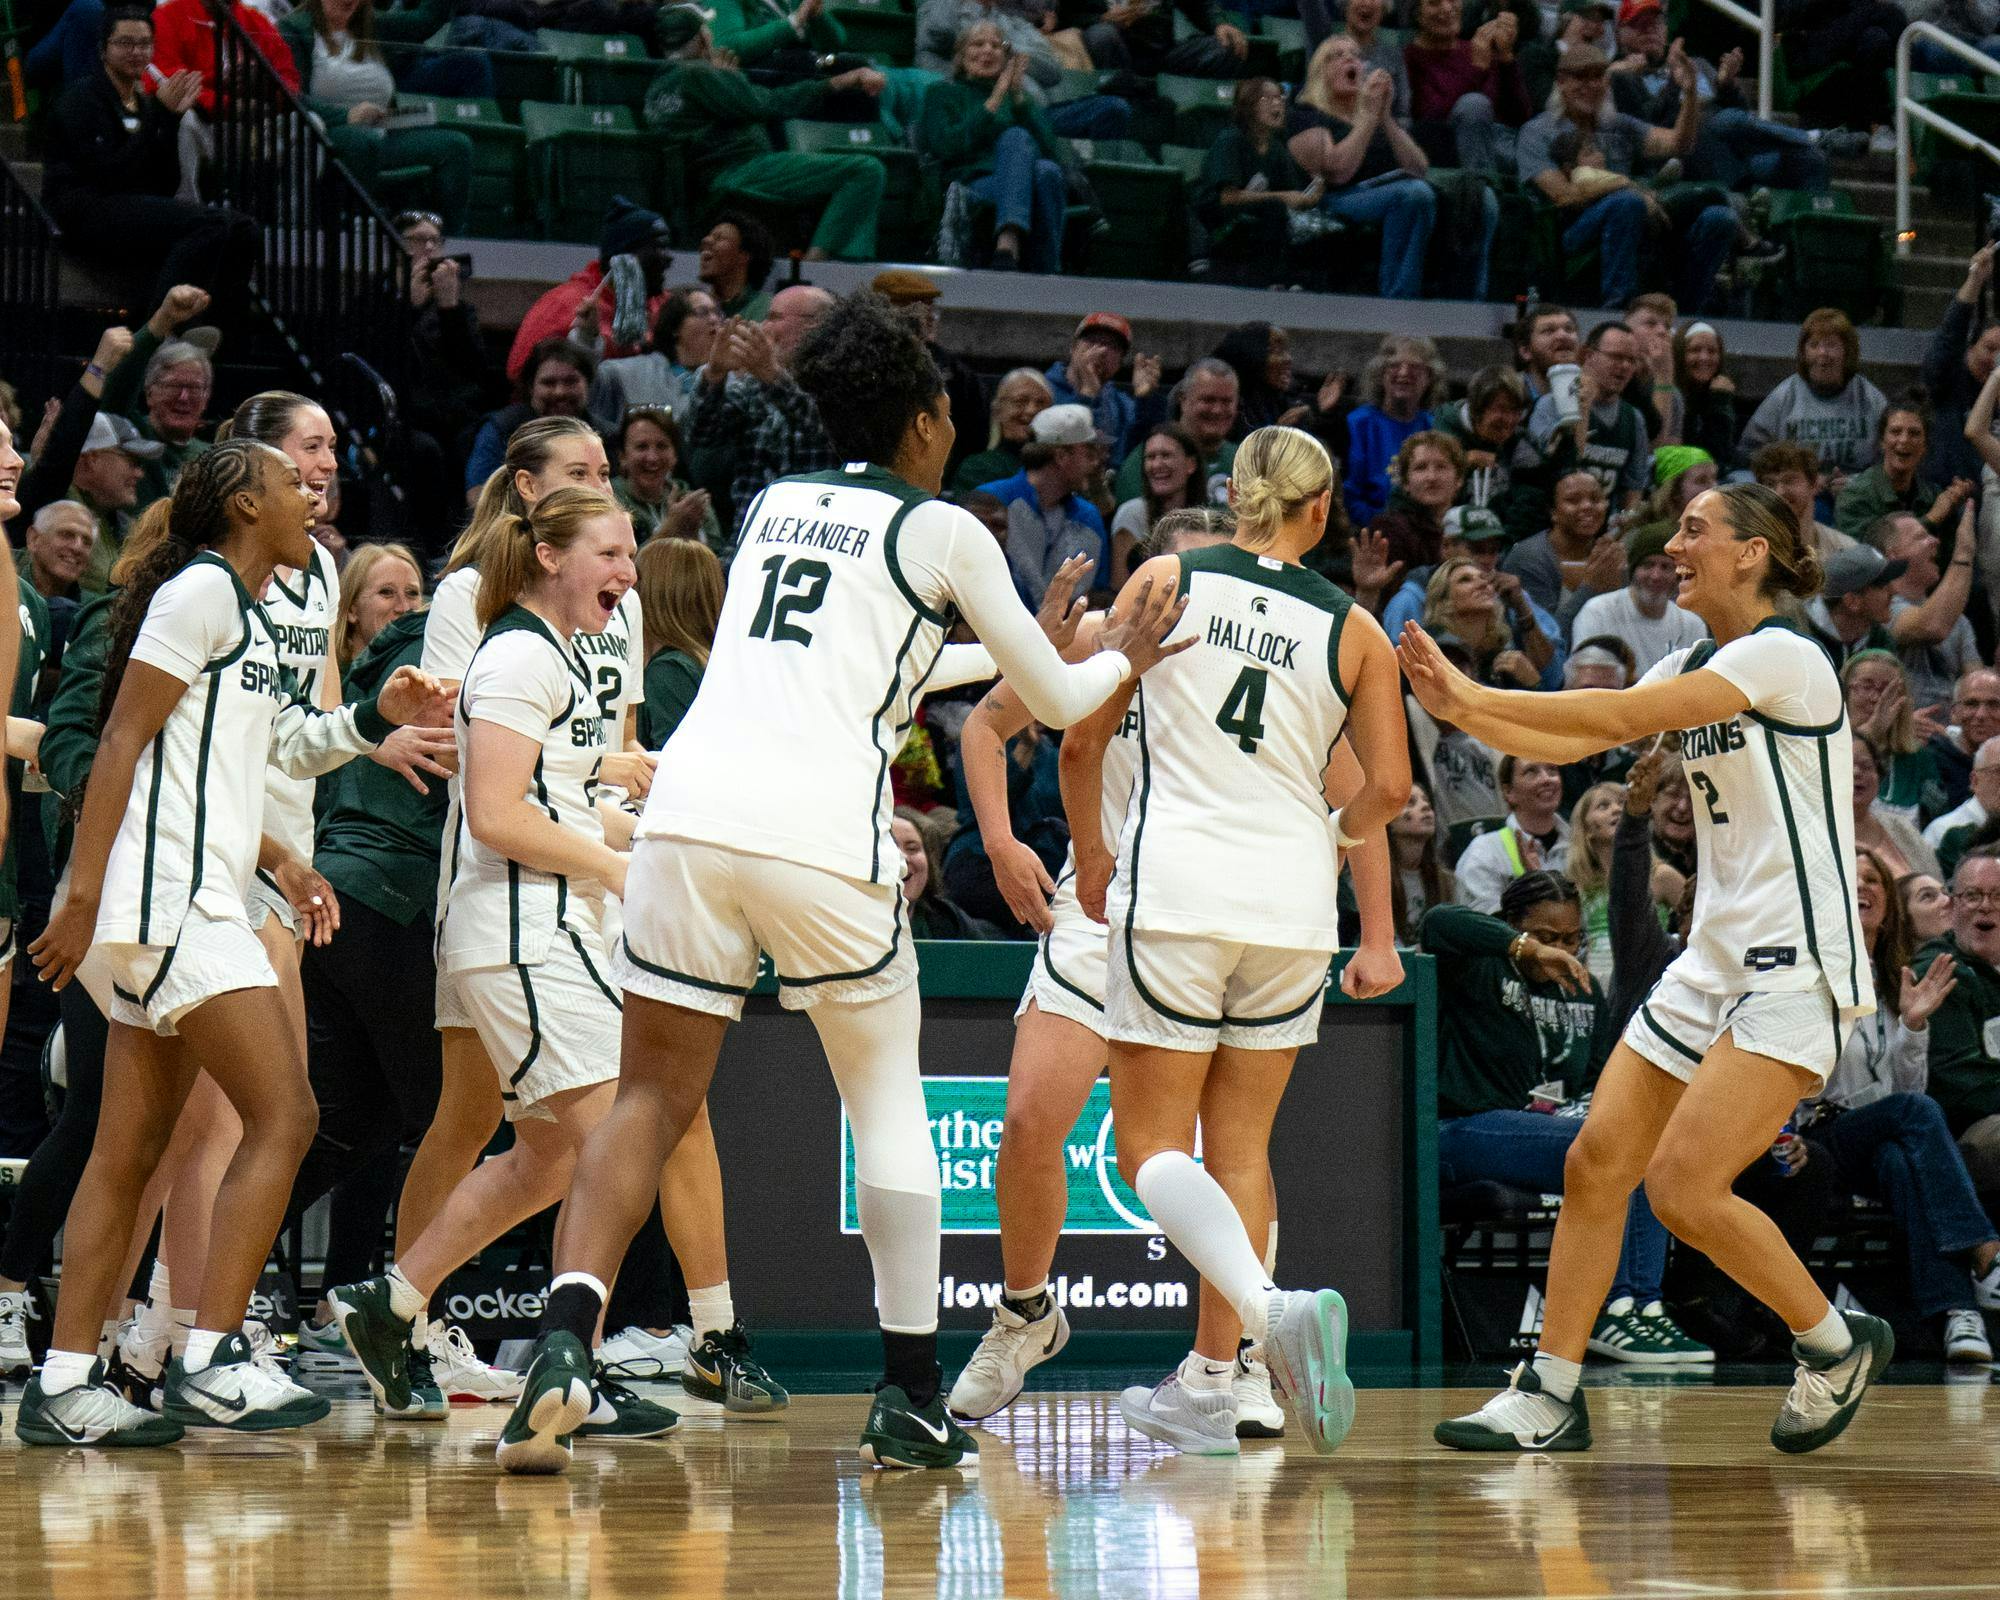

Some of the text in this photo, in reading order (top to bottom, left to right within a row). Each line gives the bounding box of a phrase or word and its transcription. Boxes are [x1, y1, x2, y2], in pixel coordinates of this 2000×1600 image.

[756, 516, 870, 559] ALEXANDER
[748, 554, 832, 649] 12
[1206, 614, 1302, 671] HALLOCK
[1215, 665, 1269, 754] 4
[1691, 770, 1730, 825] 2
[941, 1150, 998, 1190] ist
[1146, 1236, 1168, 1261] S
[446, 1286, 550, 1320] ocket
